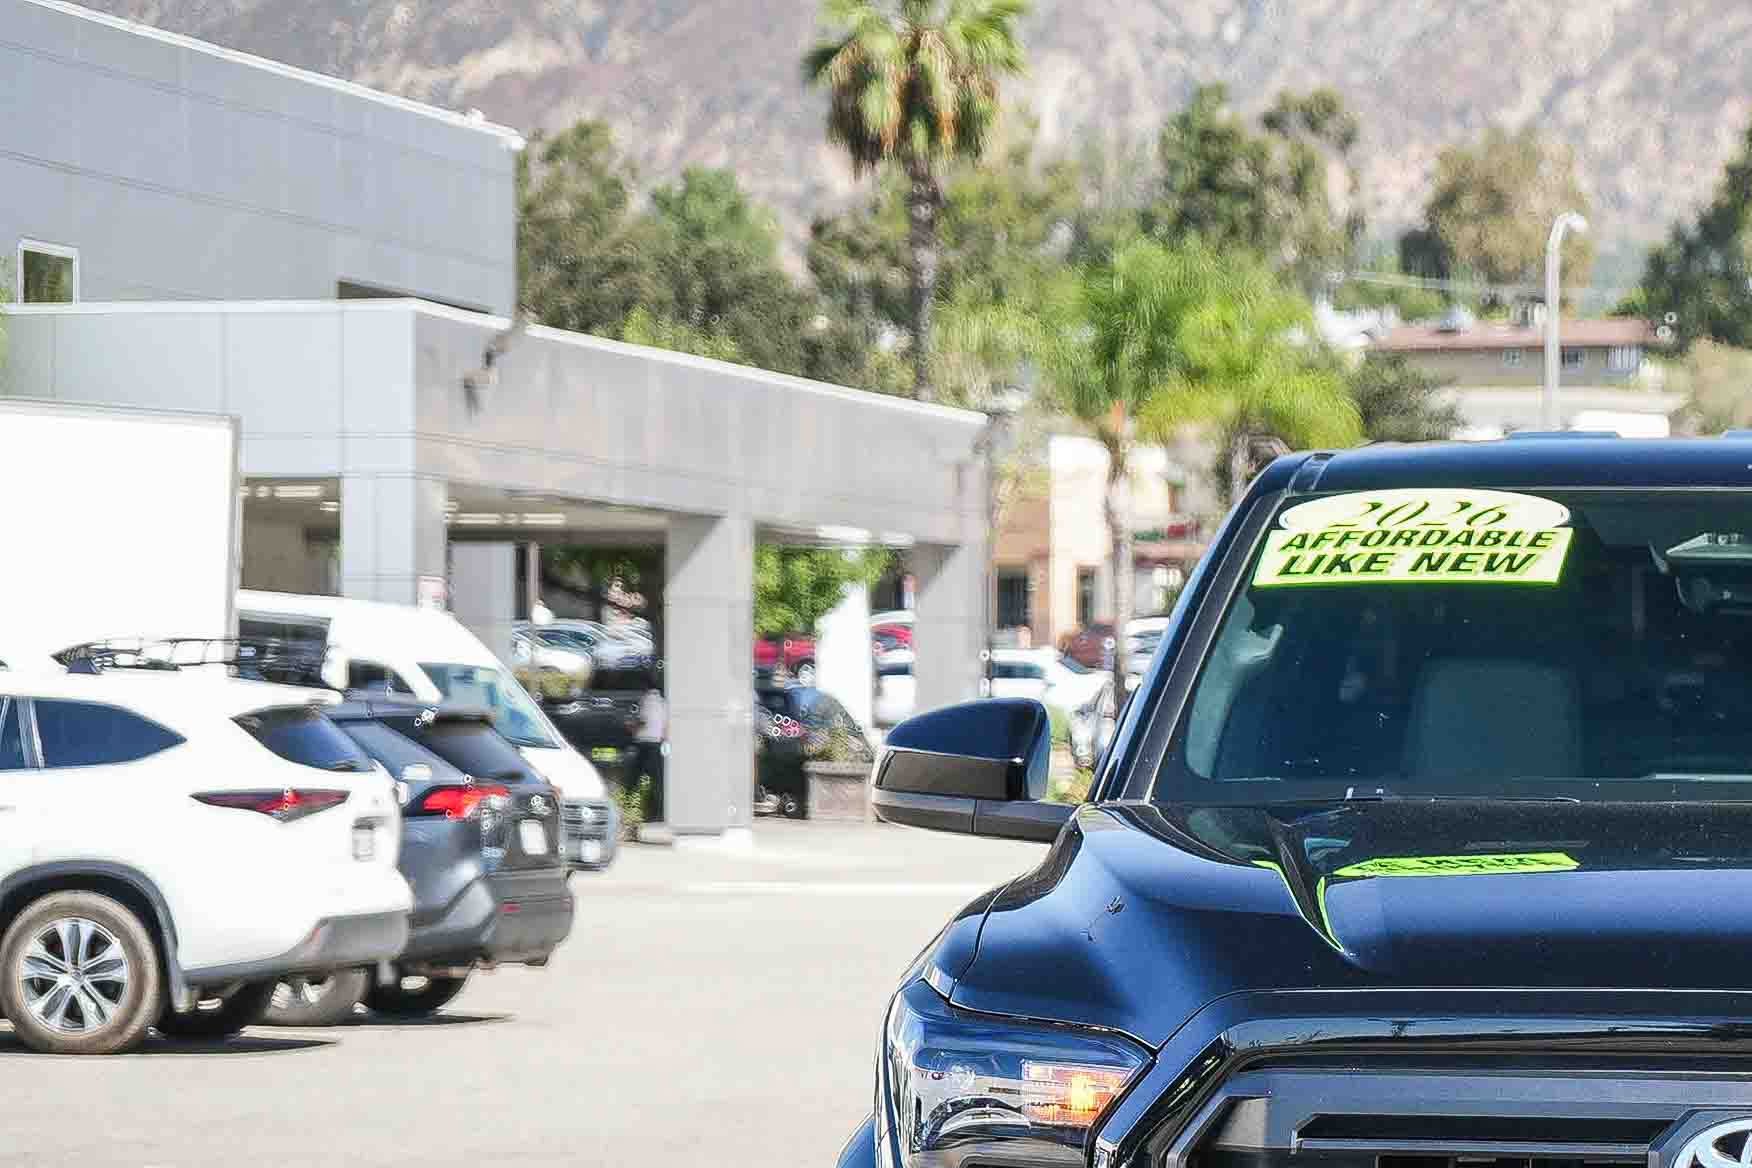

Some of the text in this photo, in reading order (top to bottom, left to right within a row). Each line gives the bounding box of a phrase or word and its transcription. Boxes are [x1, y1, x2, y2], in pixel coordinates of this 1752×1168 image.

[1279, 530, 1557, 550] AFFORDABLE
[1277, 552, 1537, 576] LIKE NEW
